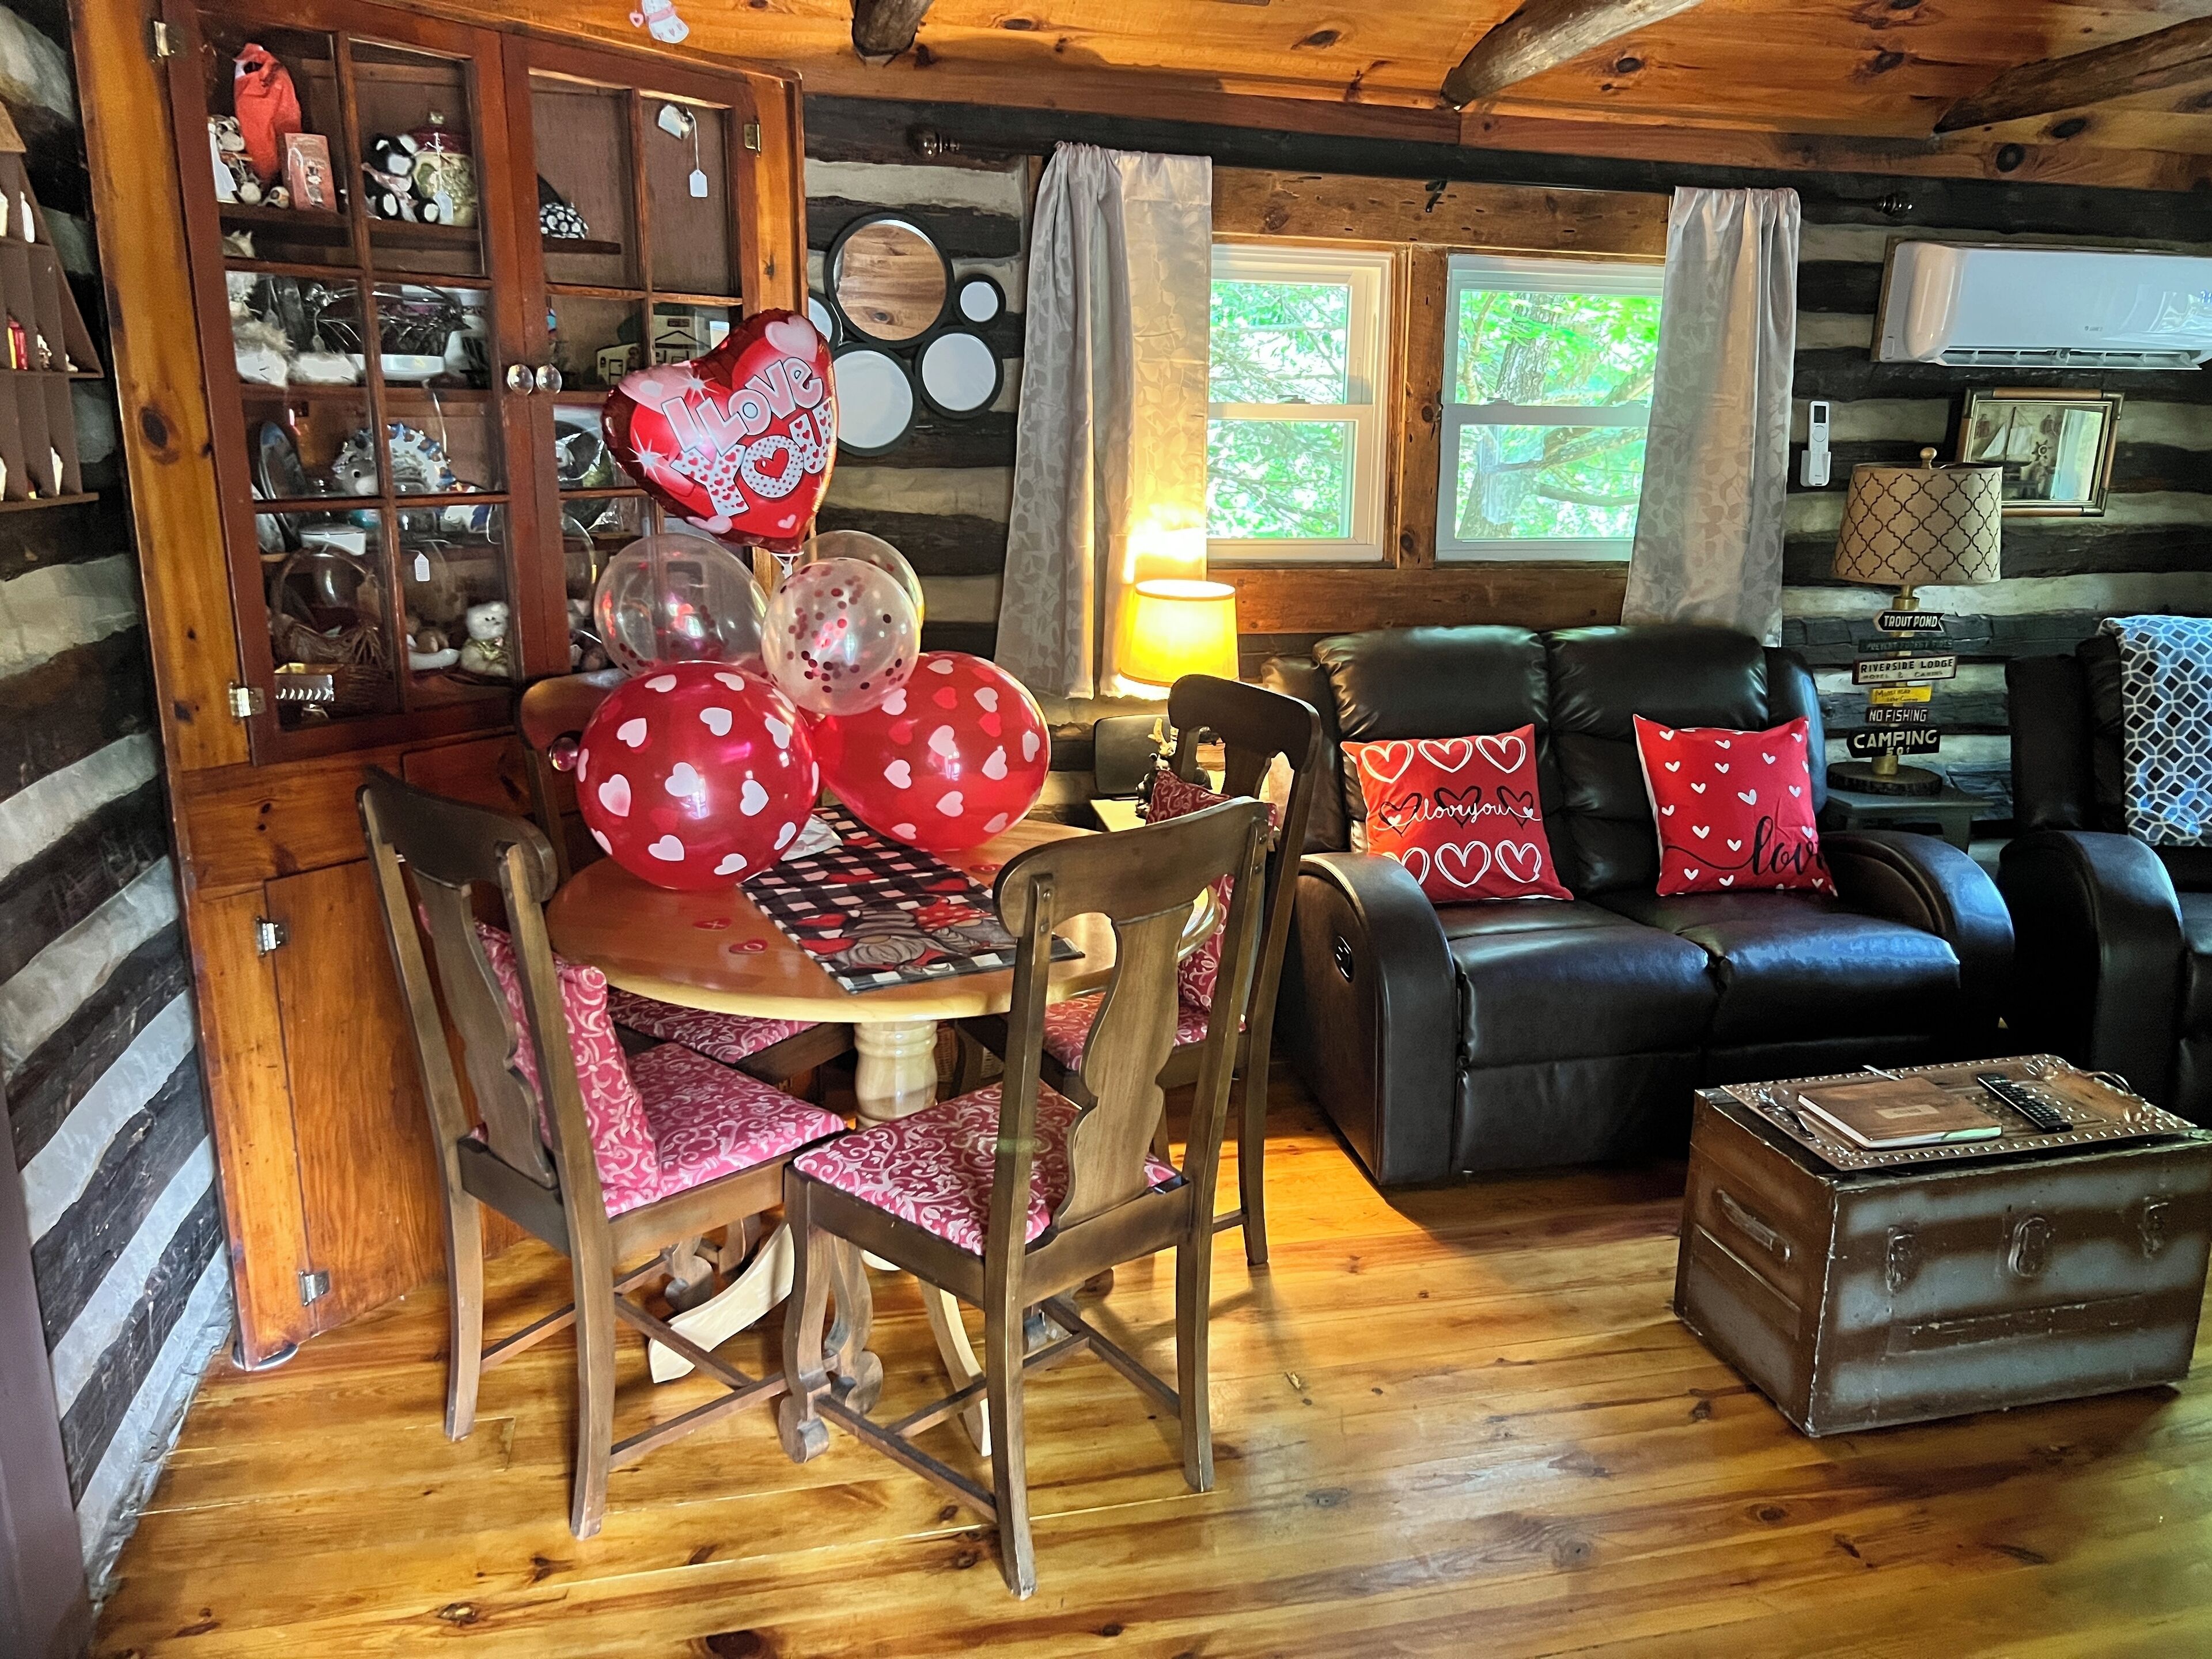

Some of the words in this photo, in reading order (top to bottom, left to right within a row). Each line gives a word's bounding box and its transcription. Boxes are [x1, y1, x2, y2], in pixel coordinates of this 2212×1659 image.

[661, 396, 704, 452] I
[669, 397, 835, 517] YOU
[1884, 615, 1913, 627] TROUT
[1913, 615, 1938, 627] POND
[1861, 661, 1914, 673] RIVERSIDE
[1921, 658, 1953, 669] LODGE
[1869, 709, 1883, 722] NO
[1885, 709, 1928, 722] FISHING
[1853, 729, 1937, 748] CAMPING
